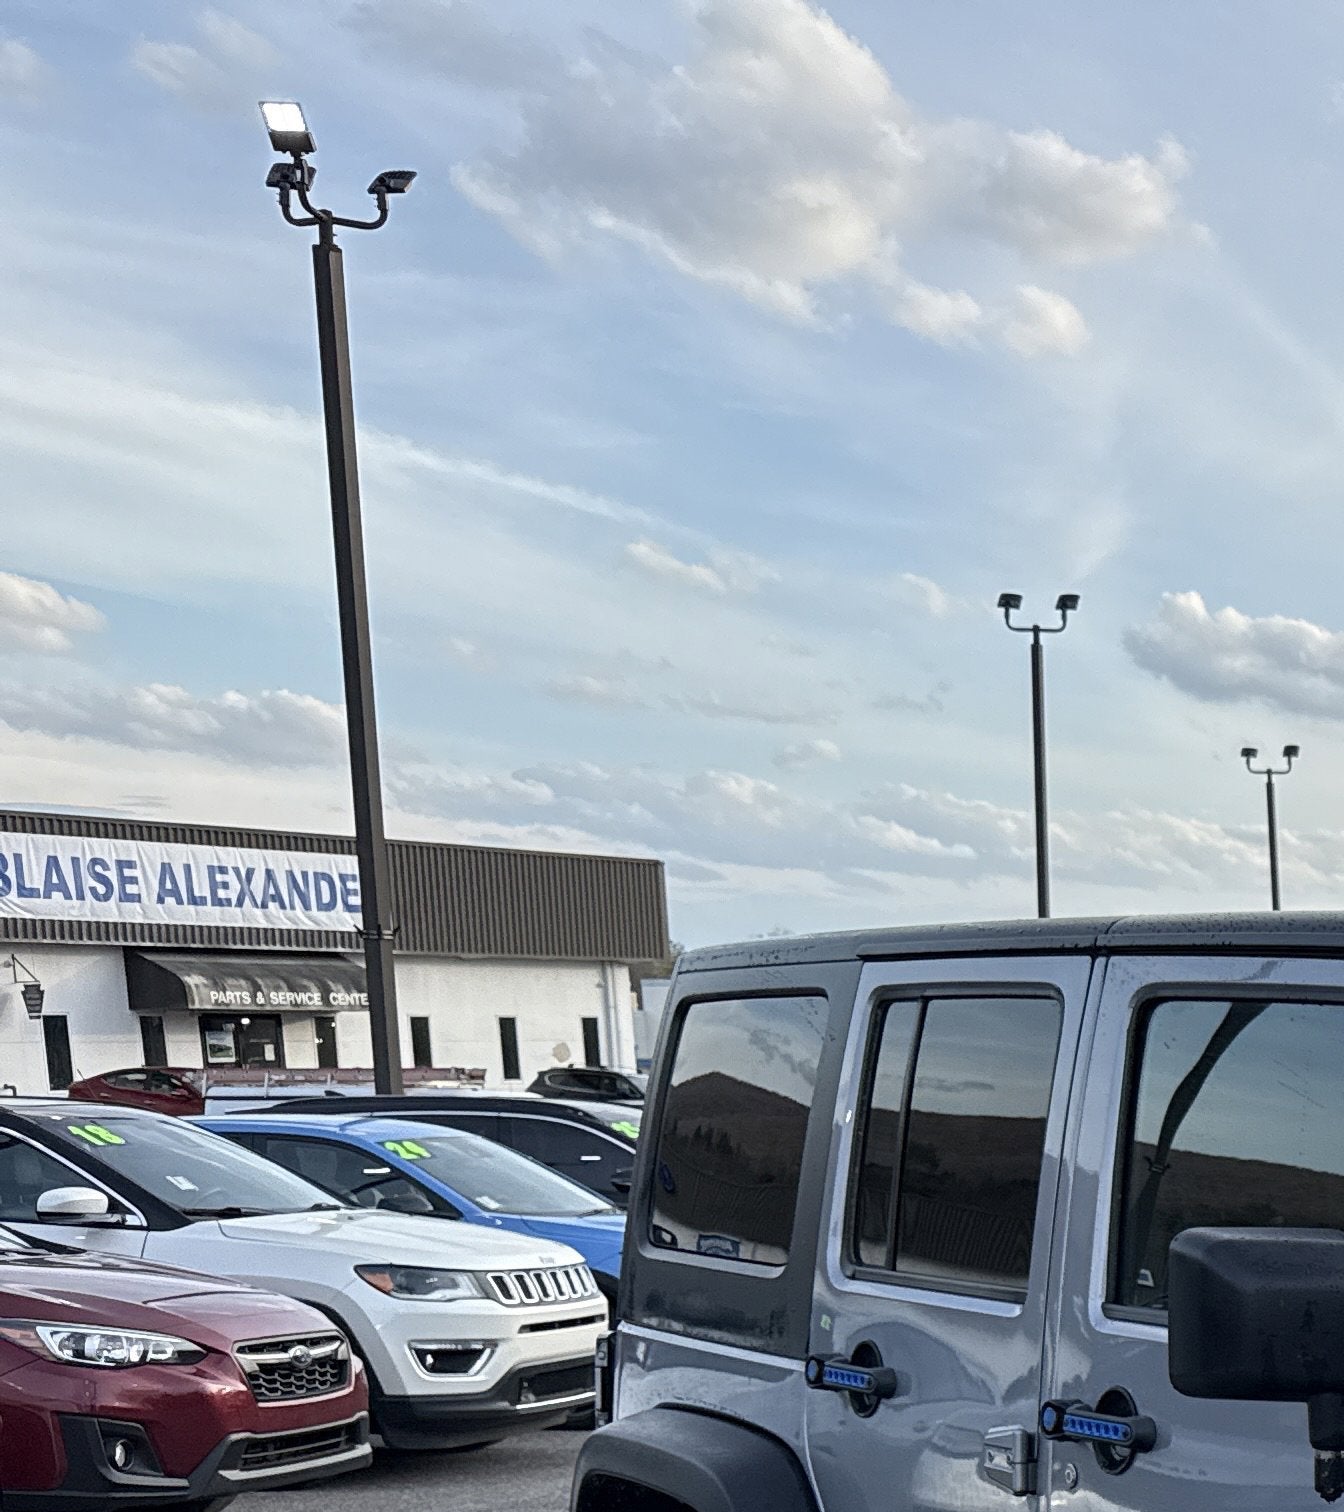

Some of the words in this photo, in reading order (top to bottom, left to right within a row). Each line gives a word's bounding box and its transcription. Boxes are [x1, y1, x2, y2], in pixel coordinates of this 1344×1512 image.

[156, 861, 362, 914] ALEXANDE
[209, 990, 251, 1005] PARTS
[256, 992, 266, 1005] &
[269, 992, 323, 1006] SERVICE
[329, 992, 370, 1006] CENTE
